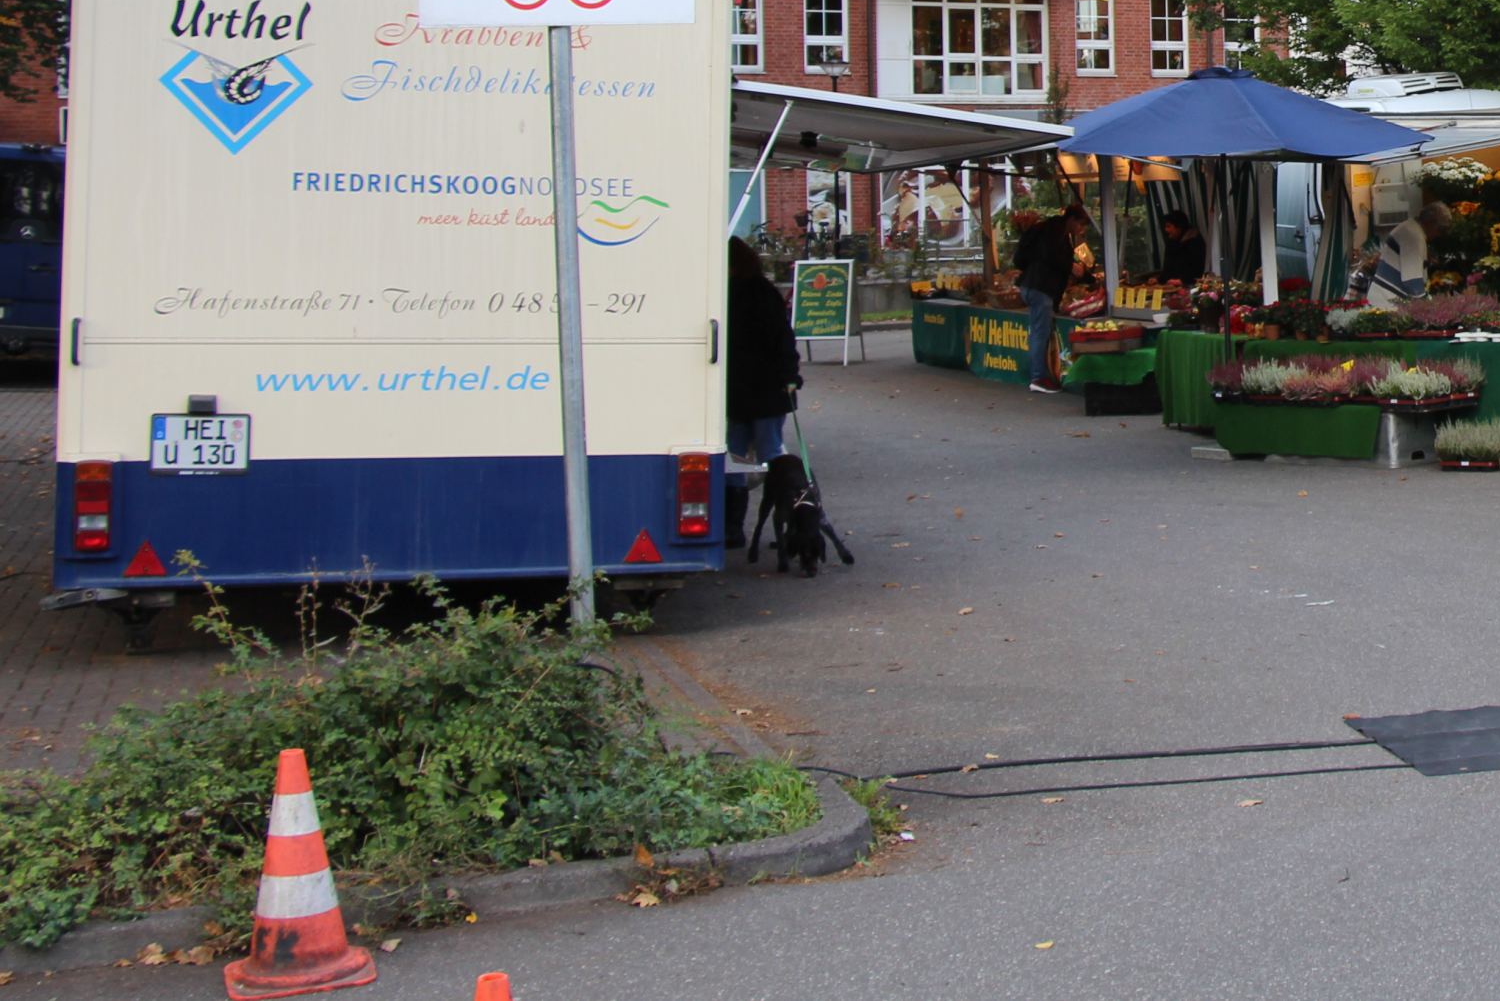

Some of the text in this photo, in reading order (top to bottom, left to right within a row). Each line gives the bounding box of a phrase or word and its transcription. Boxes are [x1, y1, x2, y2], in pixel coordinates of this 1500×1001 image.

[170, 0, 312, 40] Urthel
[340, 60, 656, 101] Fischdelikessen
[292, 171, 634, 198] FRIEDRICHSKOOGNODSEE
[417, 212, 461, 226] meer
[467, 206, 510, 227] küst
[153, 287, 333, 319] Hafenstraße
[338, 293, 361, 311] 71
[382, 287, 476, 319] Telefon
[487, 292, 505, 313] 0
[511, 292, 544, 314] 48
[604, 293, 647, 315] 291
[255, 364, 551, 391] www.urthel.de
[184, 419, 227, 440] HEI
[164, 444, 236, 465] U 130
